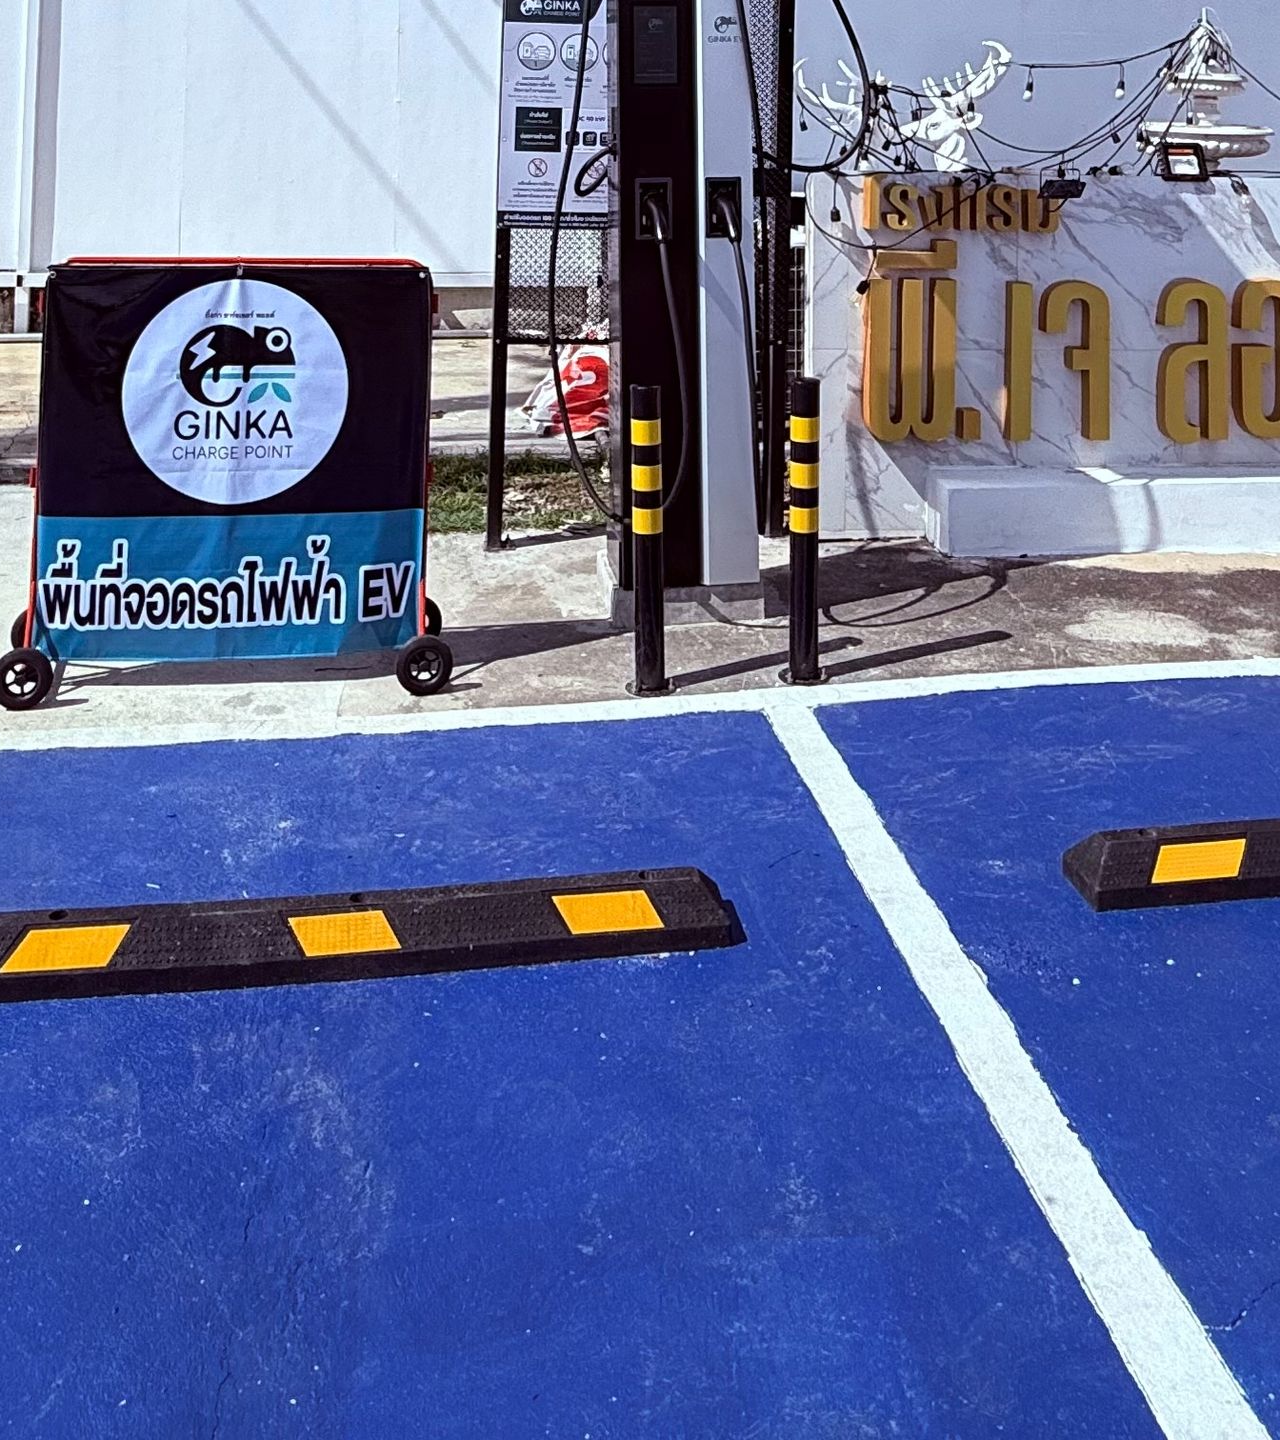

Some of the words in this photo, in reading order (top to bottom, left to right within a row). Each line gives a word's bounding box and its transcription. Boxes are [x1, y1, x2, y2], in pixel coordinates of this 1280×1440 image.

[543, 0, 581, 11] GINKA
[173, 409, 293, 441] GINKA
[172, 445, 240, 461] CHARGE
[244, 444, 294, 459] POINT
[41, 537, 344, 627] พื้นที่จอดรถไฟฟ้า
[360, 563, 413, 620] EV
